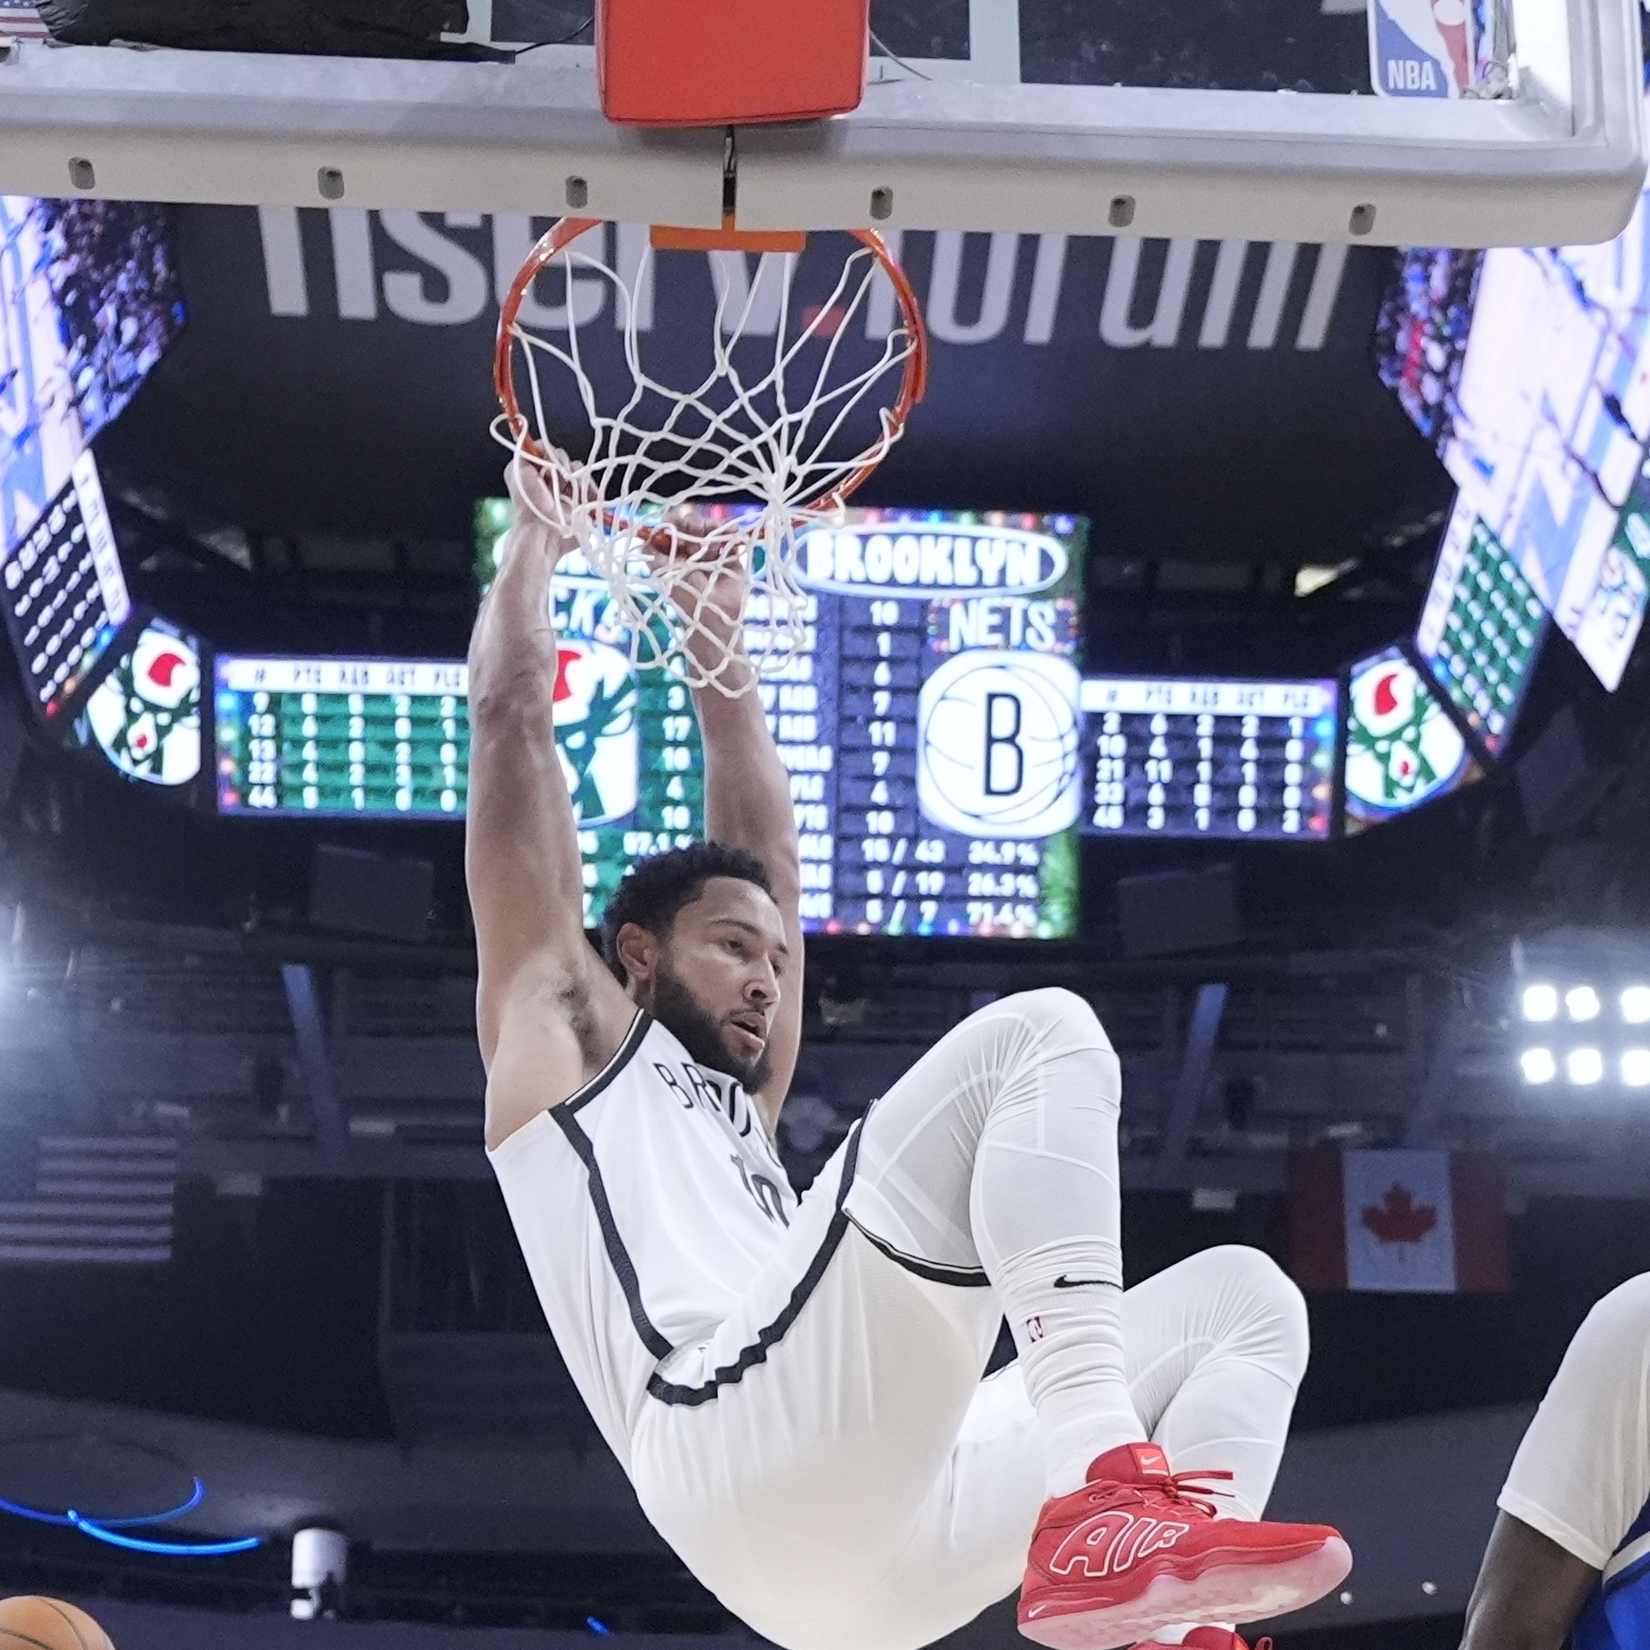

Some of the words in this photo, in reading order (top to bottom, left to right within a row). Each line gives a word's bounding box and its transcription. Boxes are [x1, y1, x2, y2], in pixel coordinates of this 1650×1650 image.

[1387, 58, 1437, 92] NBA
[806, 531, 1042, 588] BROOKLYN
[949, 597, 1057, 652] NETS
[248, 714, 276, 737] 12
[662, 715, 692, 742] 17
[868, 721, 896, 747] 11
[1103, 711, 1121, 734] 2
[1288, 716, 1304, 739] 1
[983, 692, 1024, 797] B
[248, 761, 277, 784] 22
[1096, 758, 1125, 782] 21
[1145, 759, 1173, 784] 11
[1197, 760, 1212, 784] 1
[1241, 761, 1257, 785] 1
[1194, 807, 1210, 831] 1
[914, 839, 947, 863] 43
[916, 871, 945, 895] 19
[920, 900, 939, 924] 7
[1050, 1510, 1191, 1579] AIR
